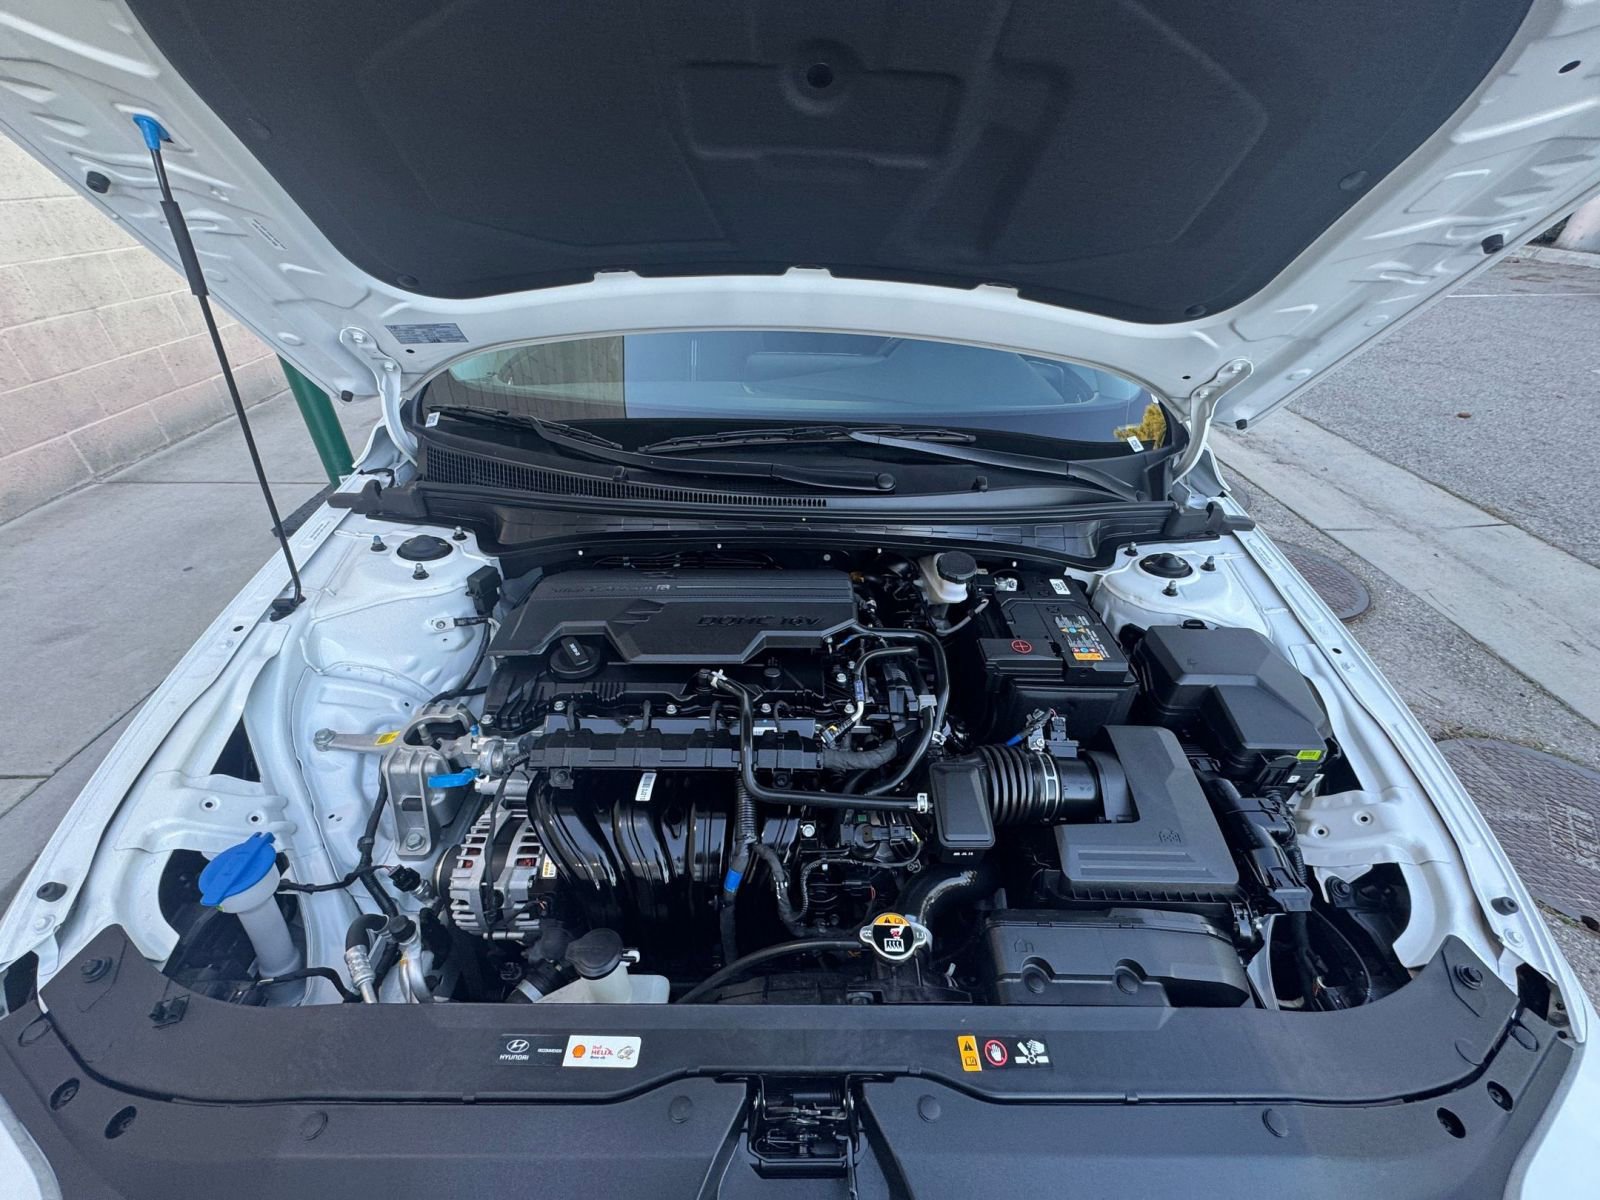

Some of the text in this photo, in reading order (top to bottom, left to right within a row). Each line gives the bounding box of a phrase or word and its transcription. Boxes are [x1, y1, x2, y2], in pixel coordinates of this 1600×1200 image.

[697, 615, 825, 626] DOHC 16V
[591, 1048, 613, 1056] HELIX
